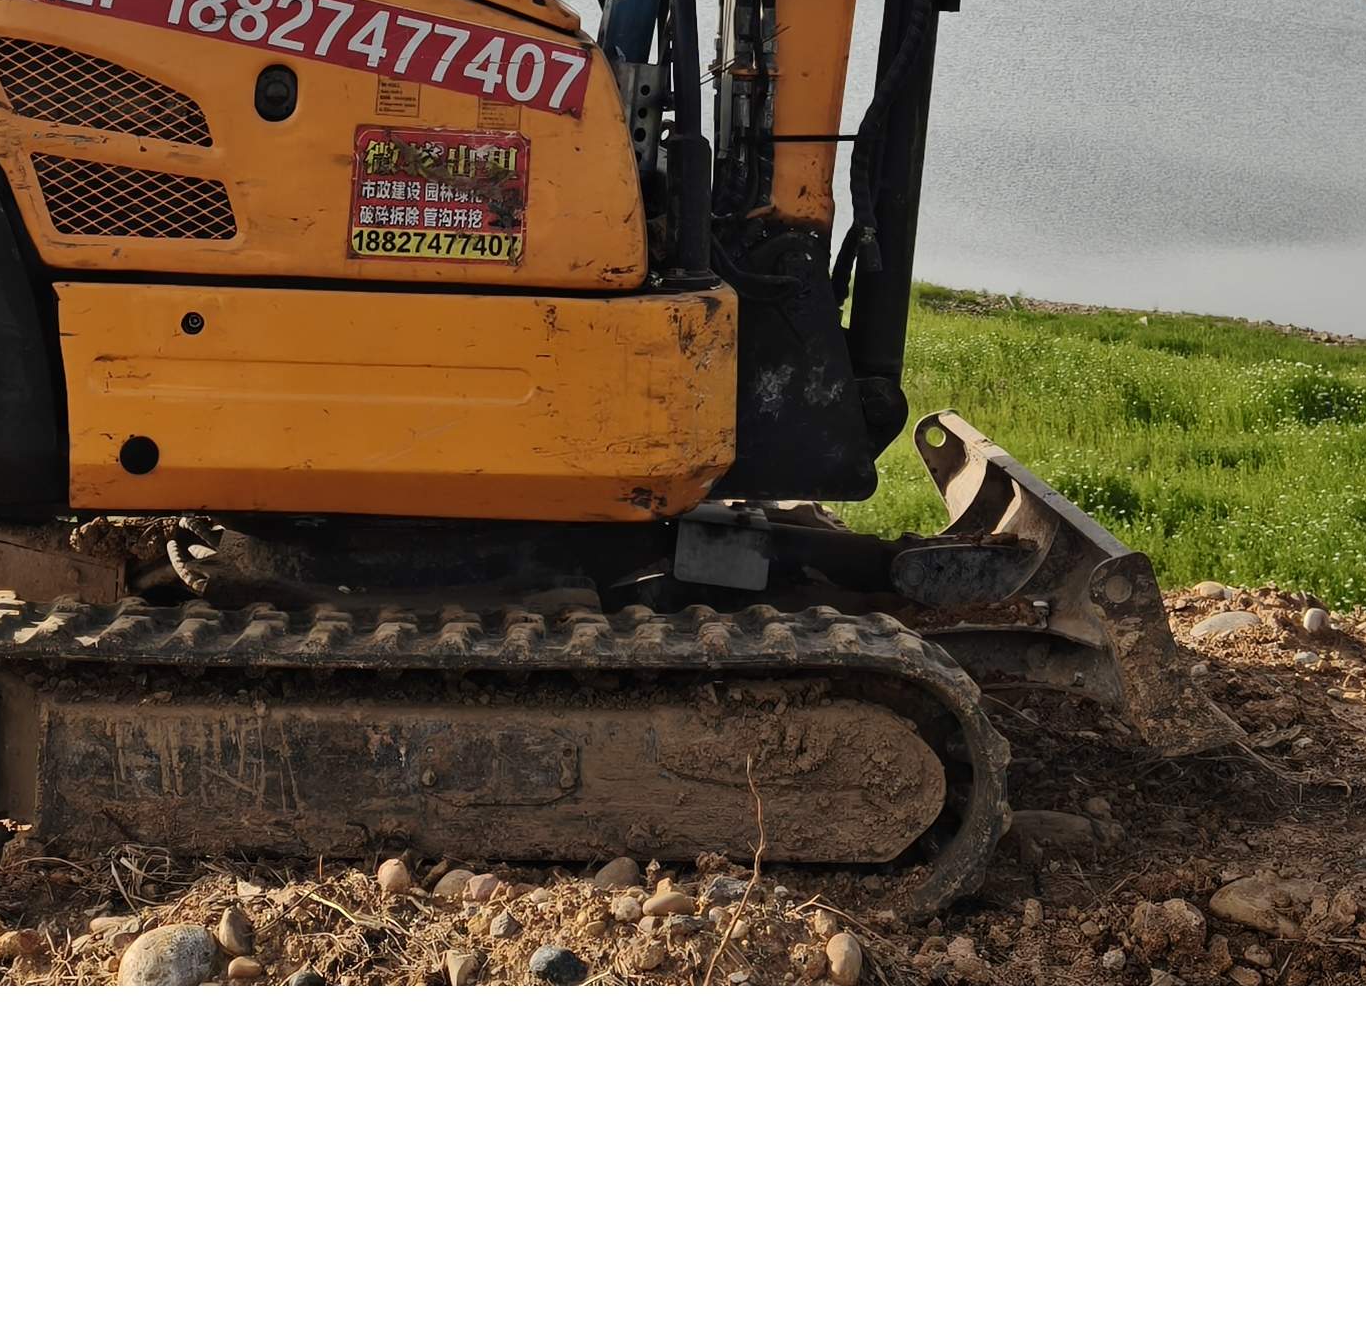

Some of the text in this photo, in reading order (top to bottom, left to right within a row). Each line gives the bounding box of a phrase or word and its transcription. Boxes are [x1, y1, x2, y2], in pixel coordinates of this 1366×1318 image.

[362, 181, 421, 201] 市政建设
[359, 205, 483, 228] 破碎拆除 管沟开挖
[354, 231, 518, 256] 18827477407
